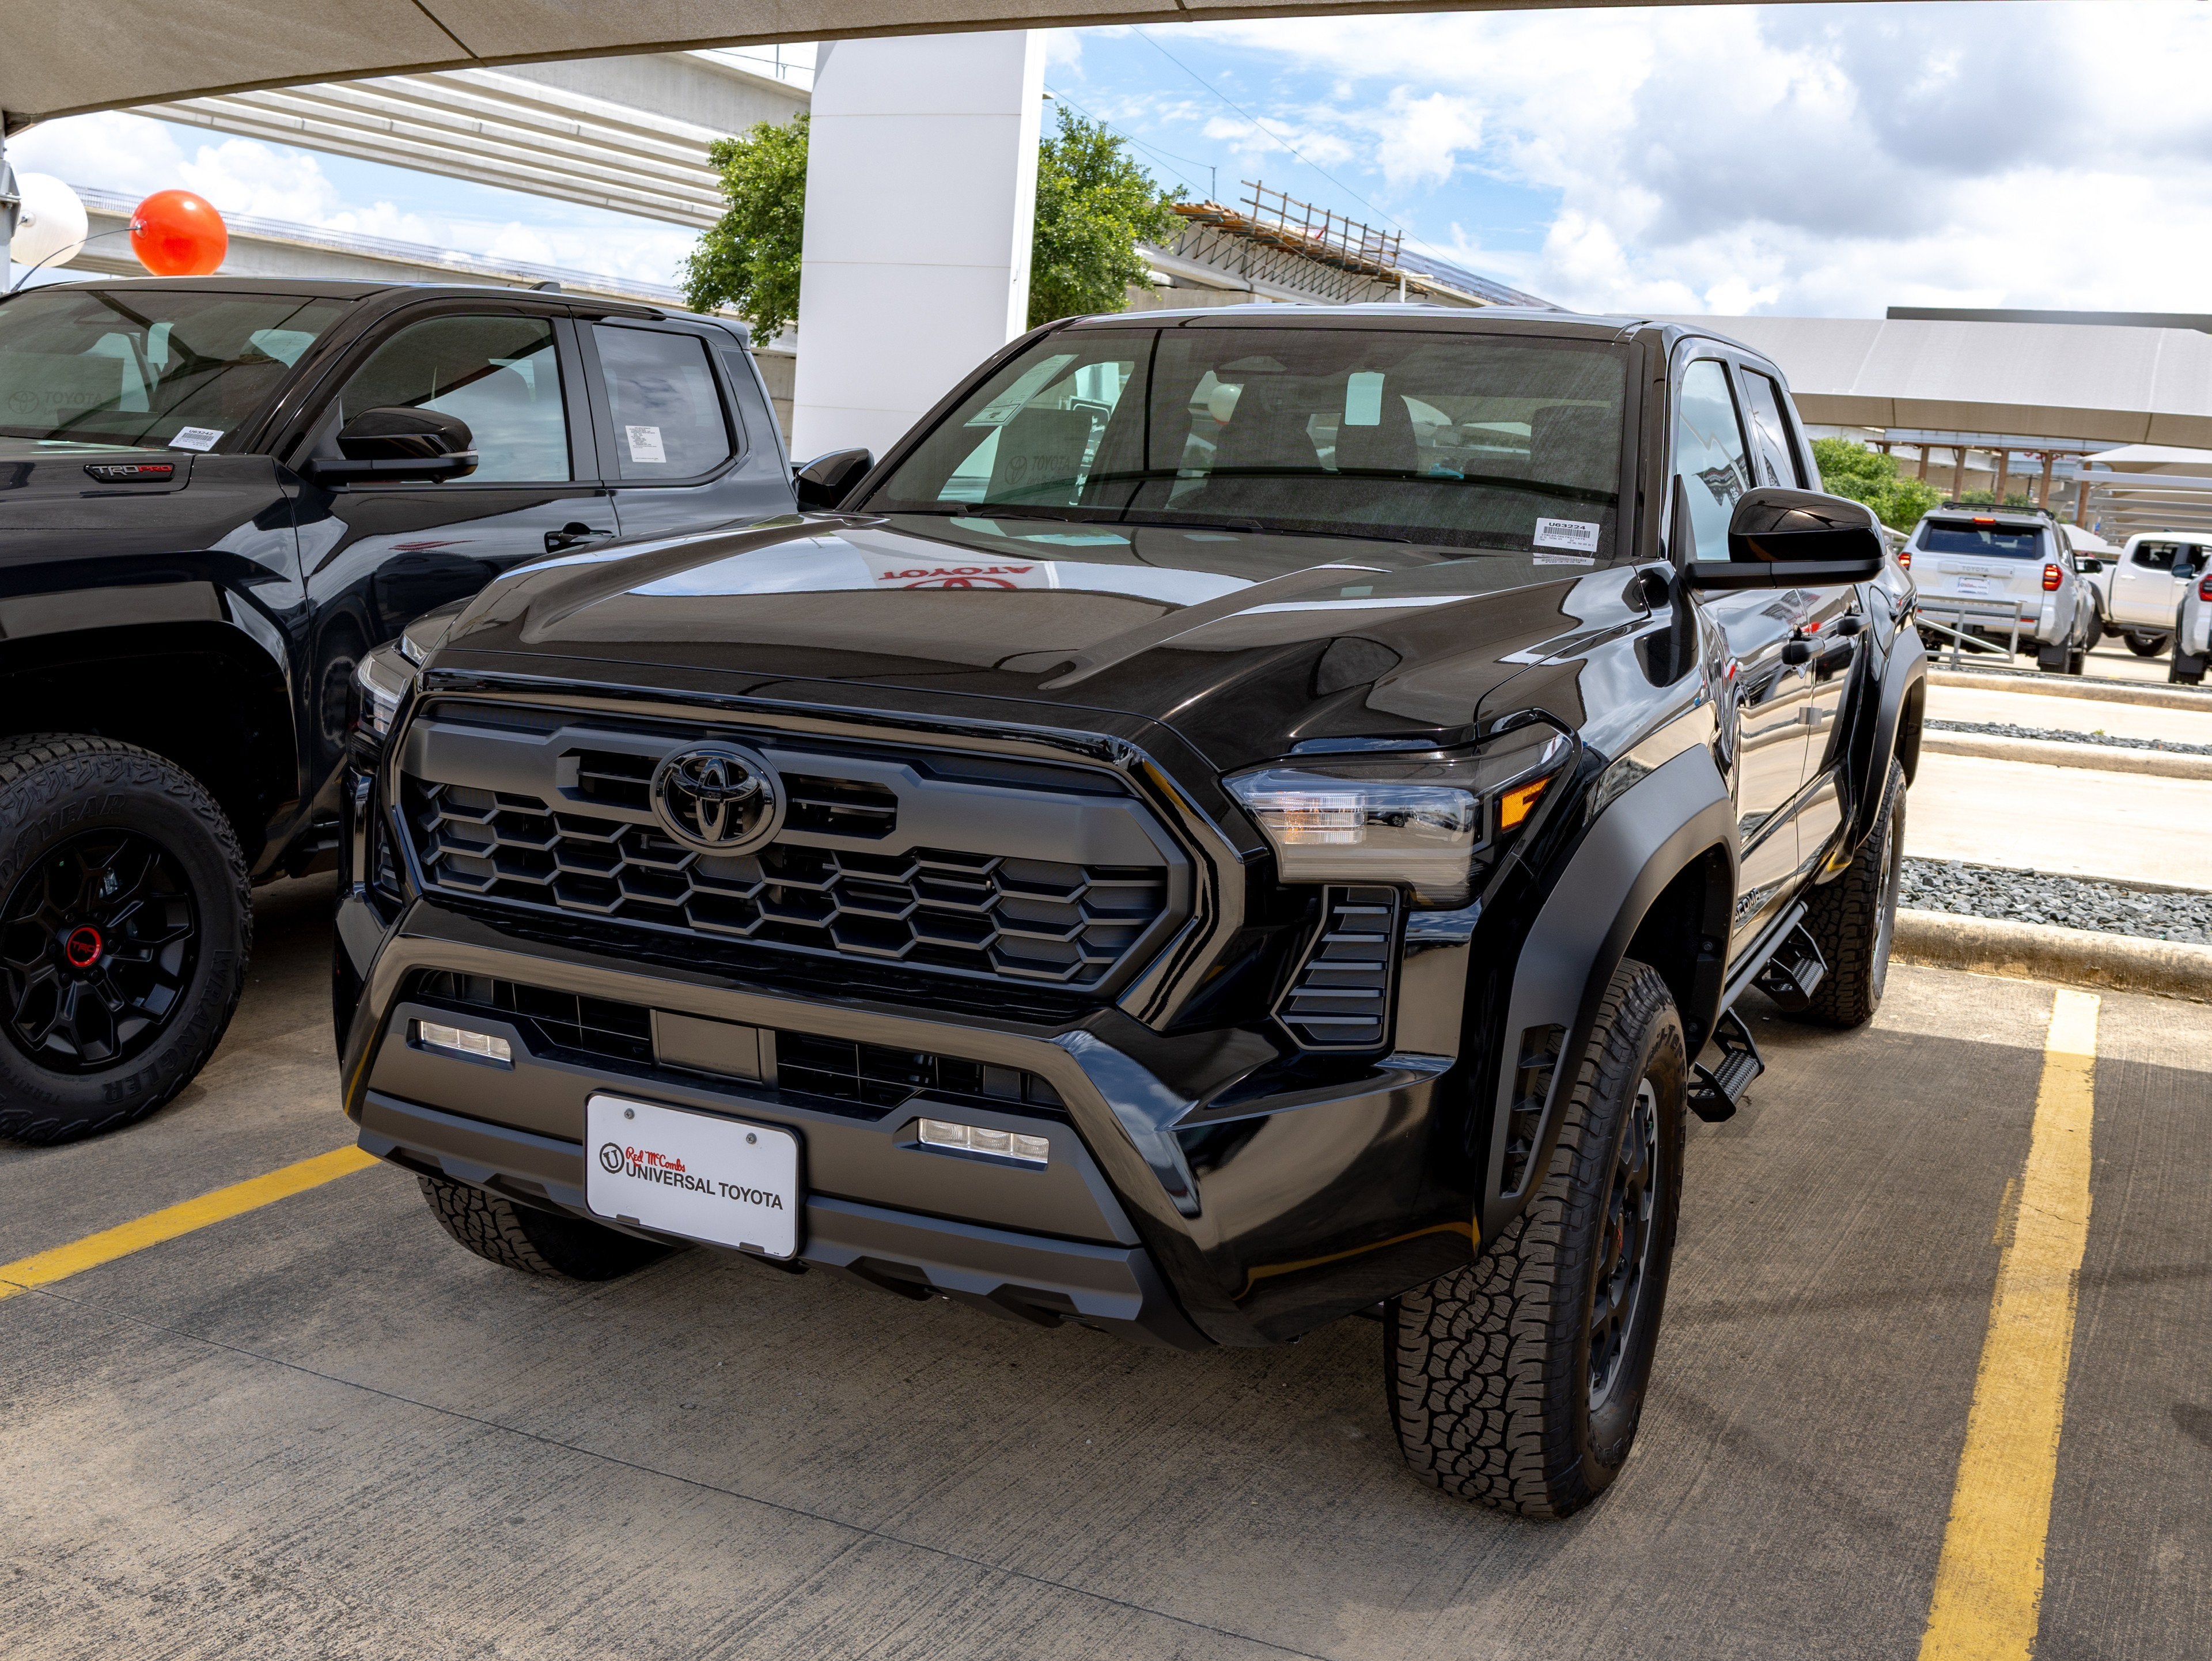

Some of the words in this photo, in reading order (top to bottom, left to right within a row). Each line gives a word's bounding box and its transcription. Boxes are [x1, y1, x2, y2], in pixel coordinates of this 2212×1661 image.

[92, 466, 139, 476] TRD
[72, 941, 96, 954] TRD
[103, 949, 234, 1104] WRANGLER
[626, 1146, 644, 1167] Red
[645, 1150, 685, 1173] McCombs
[626, 1162, 716, 1195] UNIVERSAL
[719, 1182, 783, 1210] TOYOTA
